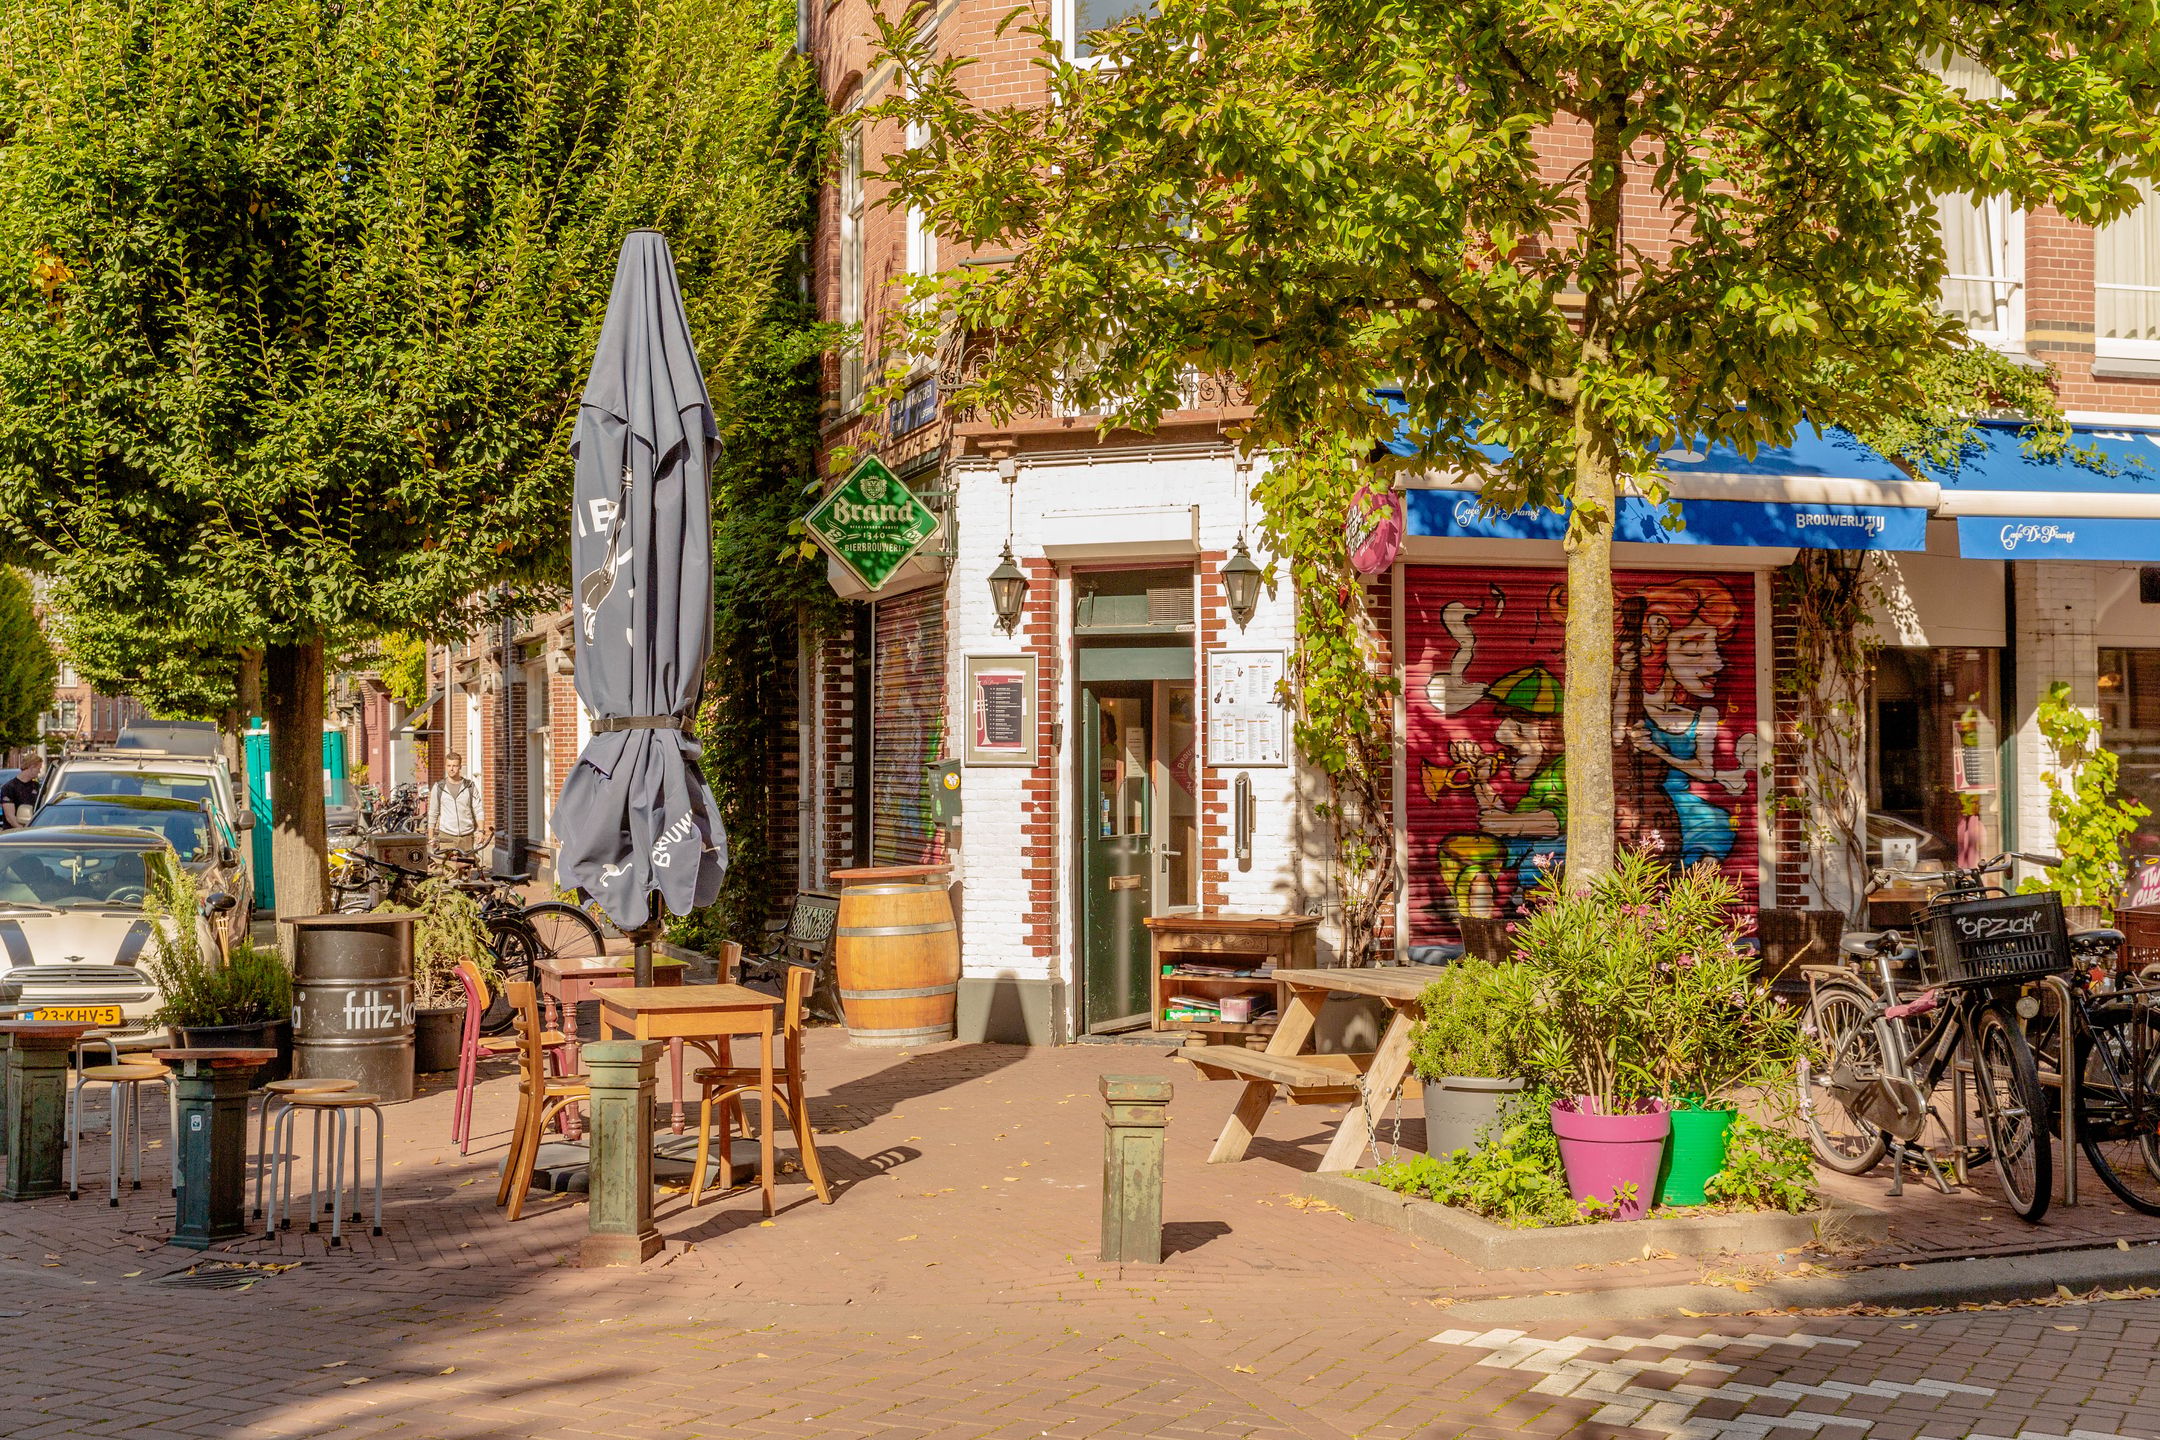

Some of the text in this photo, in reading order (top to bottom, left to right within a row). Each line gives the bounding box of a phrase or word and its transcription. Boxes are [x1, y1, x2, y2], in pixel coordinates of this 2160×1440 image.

[833, 496, 914, 525] Brand
[863, 532, 886, 540] 1340
[40, 1009, 115, 1022] 23-KHV-5
